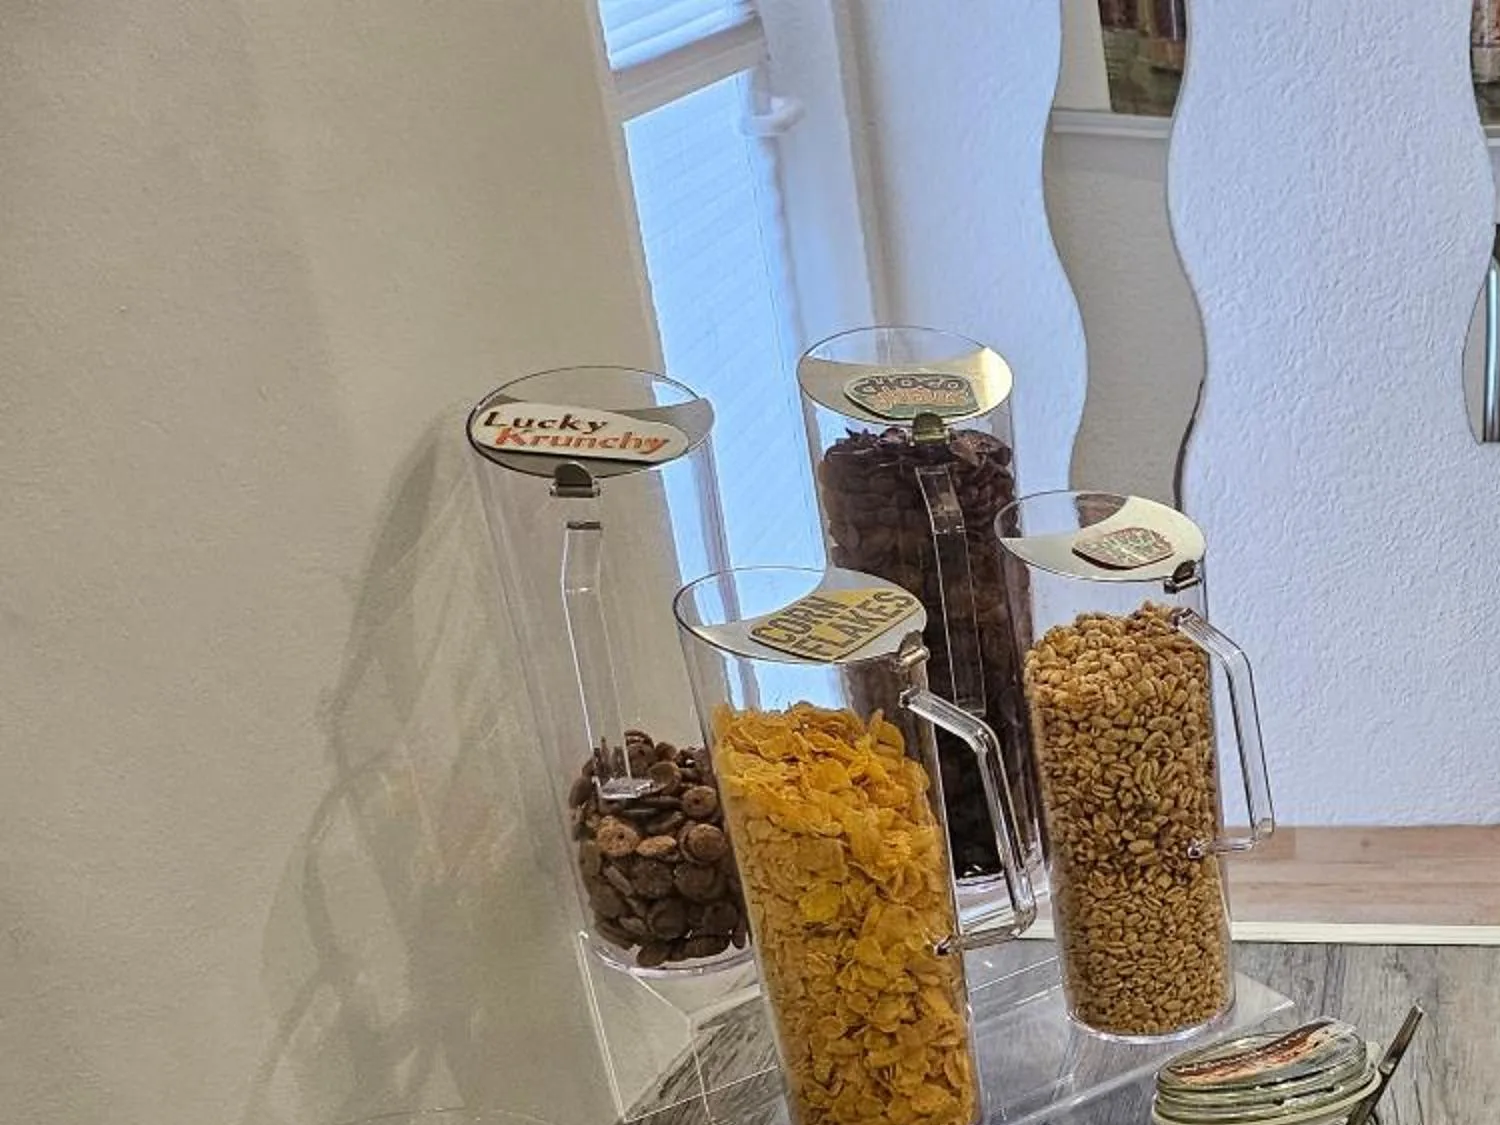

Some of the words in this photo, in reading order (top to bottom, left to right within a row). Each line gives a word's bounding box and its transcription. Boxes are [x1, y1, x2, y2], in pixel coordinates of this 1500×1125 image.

[484, 411, 608, 434] Lucky
[495, 427, 669, 455] Krunchy
[751, 596, 849, 643] CORN
[790, 591, 916, 657] FLAKES
